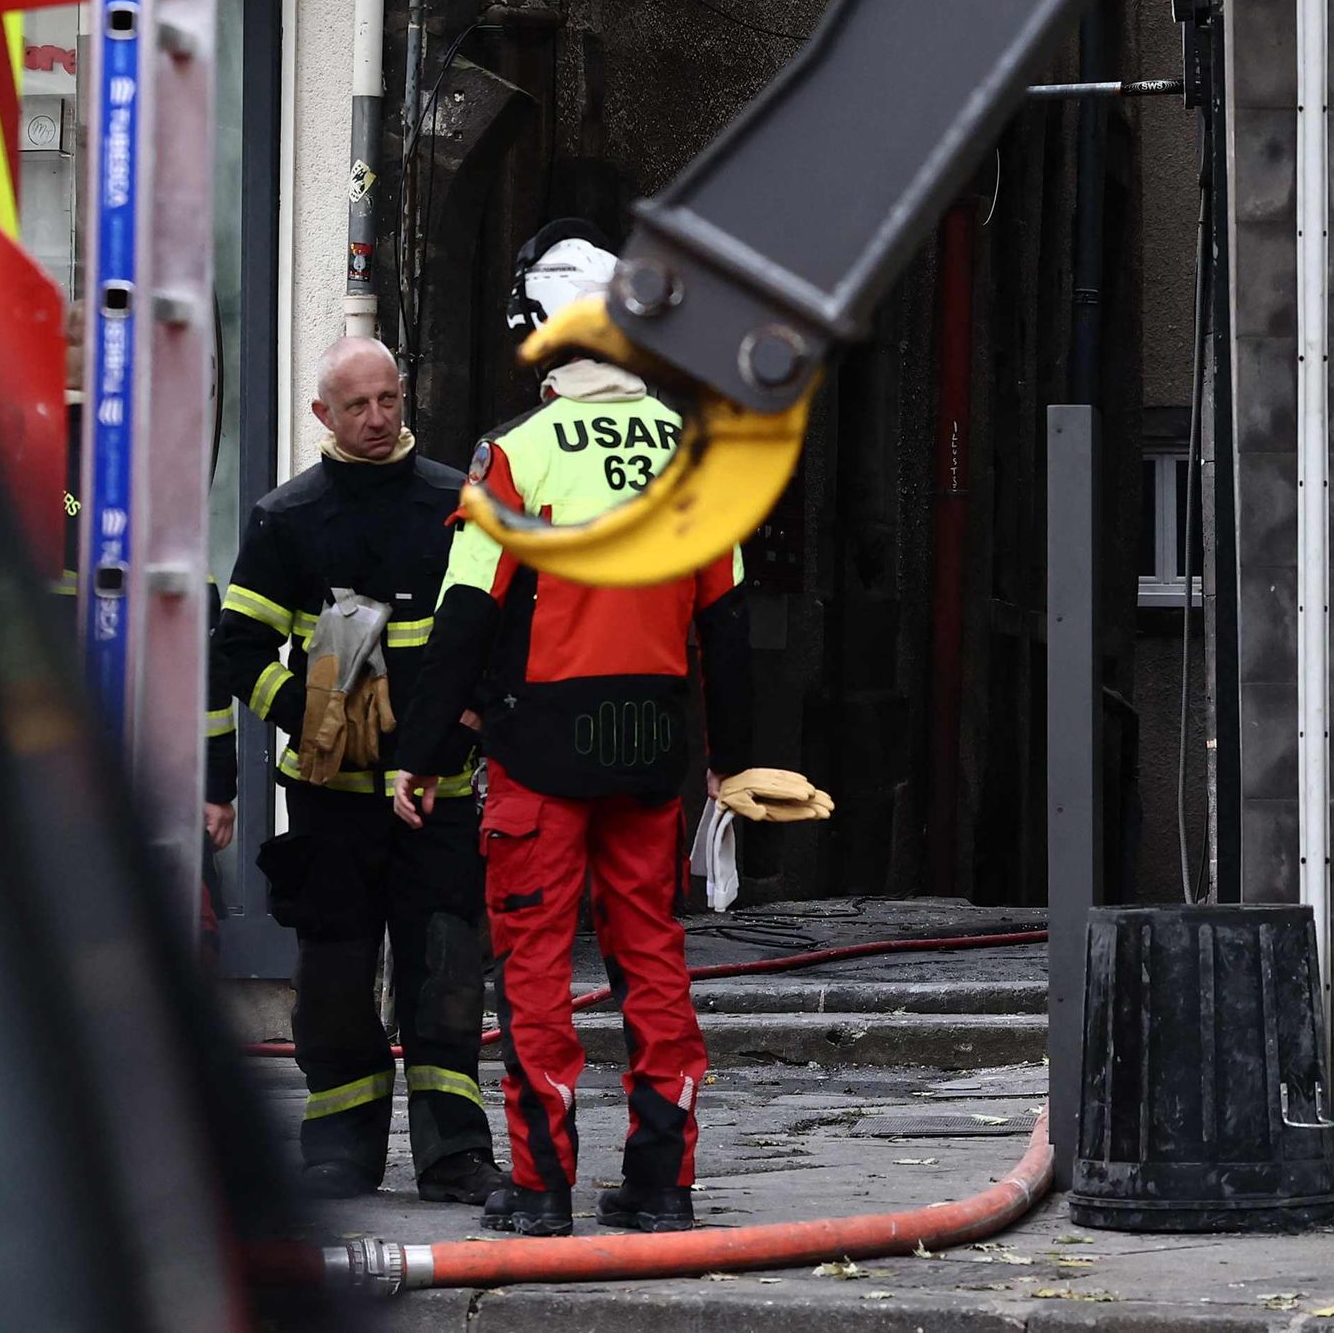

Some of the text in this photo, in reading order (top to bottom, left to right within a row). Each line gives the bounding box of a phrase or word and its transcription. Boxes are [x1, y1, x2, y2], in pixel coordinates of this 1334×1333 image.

[1141, 81, 1164, 91] SWS
[553, 417, 684, 452] USAR
[604, 455, 657, 491] 63
